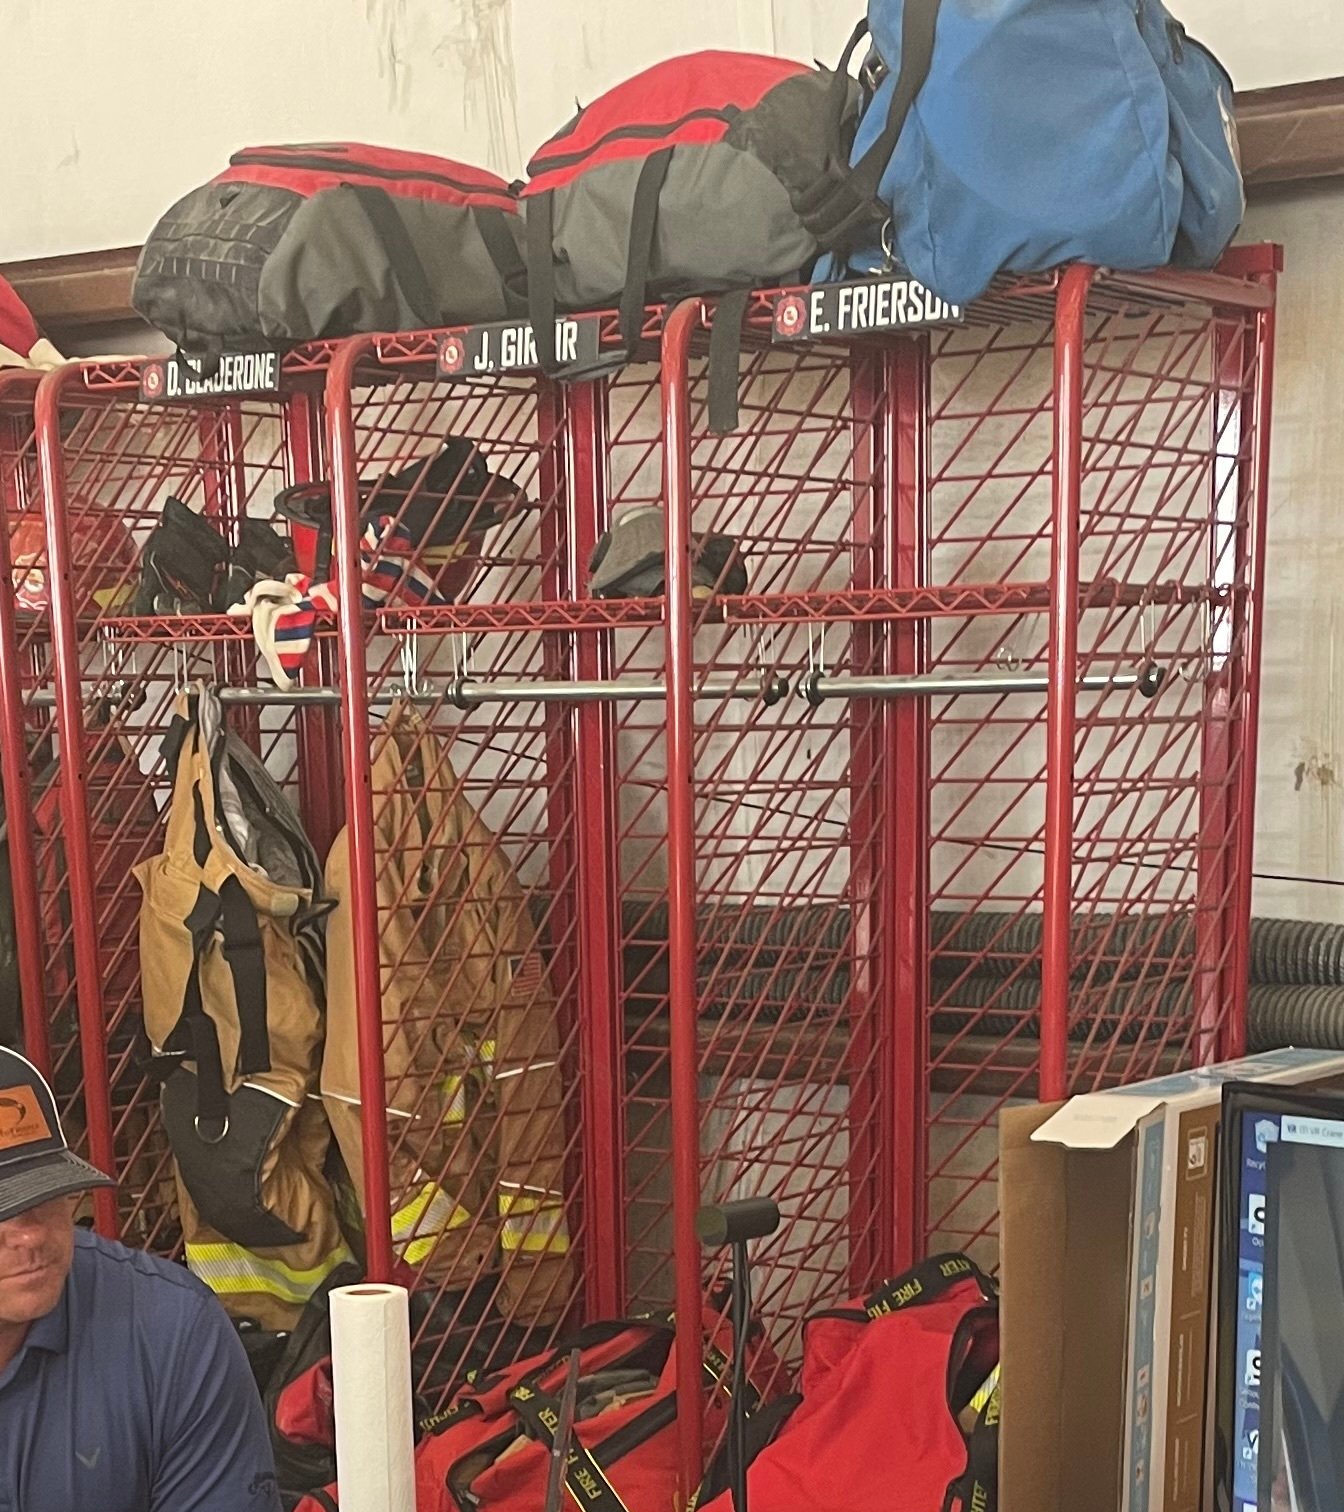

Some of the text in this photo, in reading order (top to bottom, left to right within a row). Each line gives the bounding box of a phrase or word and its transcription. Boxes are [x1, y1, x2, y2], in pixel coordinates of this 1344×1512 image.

[810, 291, 830, 334] E.
[474, 321, 578, 370] J. GIRIR
[167, 361, 181, 396] D.
[574, 1467, 603, 1500] FIRE
